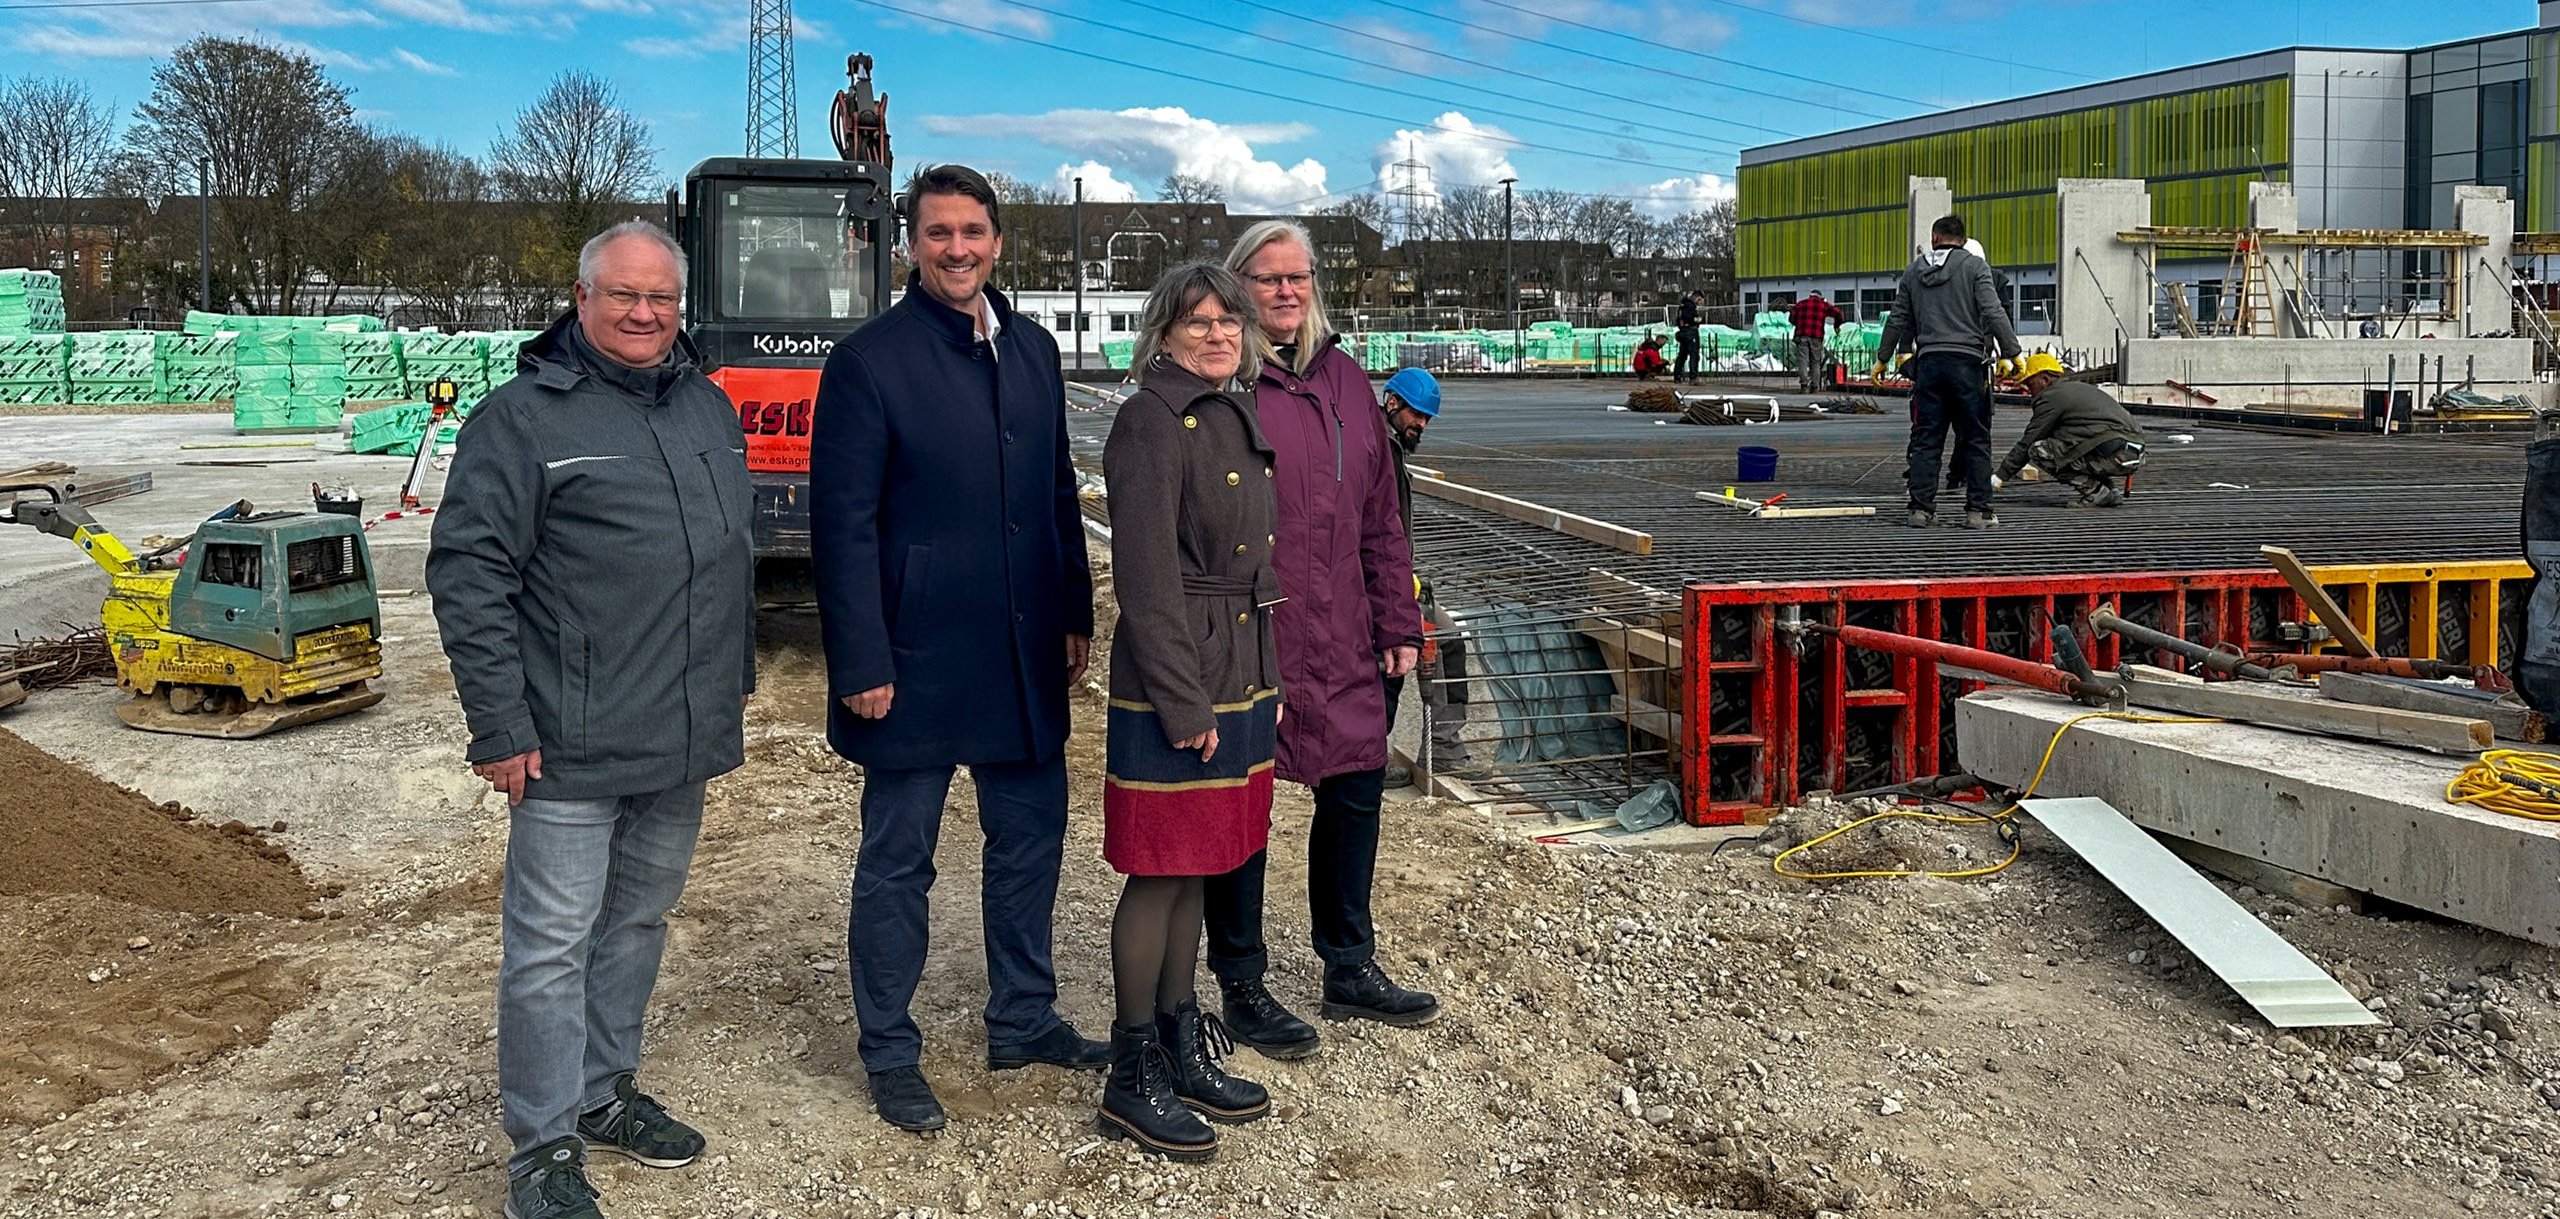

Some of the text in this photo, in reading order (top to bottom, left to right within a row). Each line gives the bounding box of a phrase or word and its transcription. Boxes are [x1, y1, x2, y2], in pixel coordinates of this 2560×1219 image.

[753, 335, 835, 354] Kubota
[740, 399, 811, 436] ESK
[2438, 605, 2466, 652] PERI
